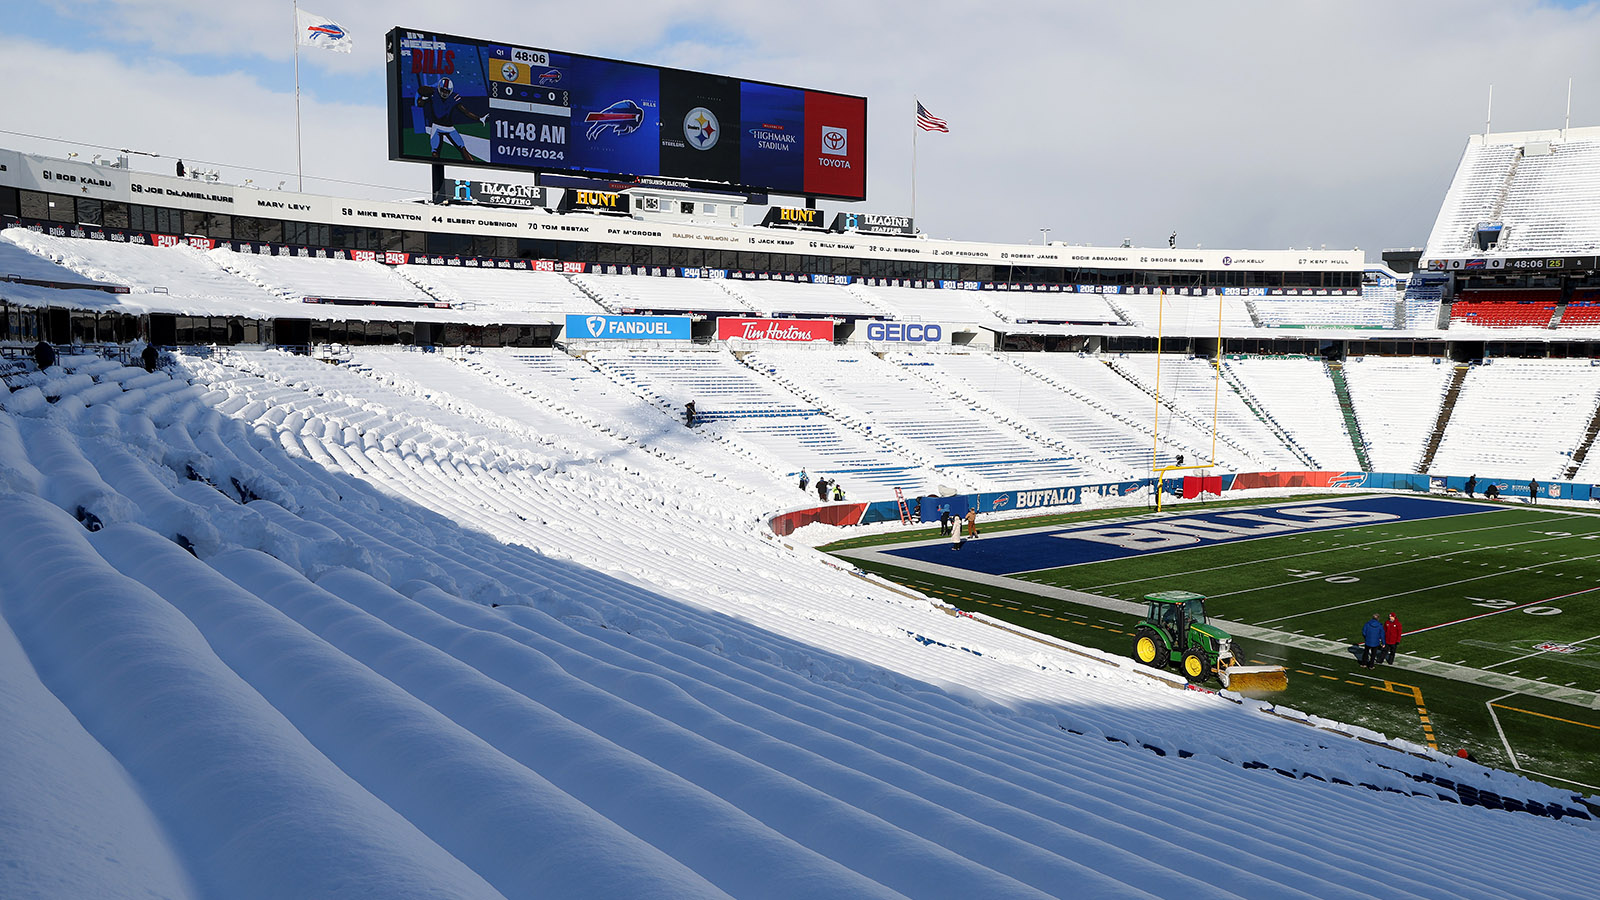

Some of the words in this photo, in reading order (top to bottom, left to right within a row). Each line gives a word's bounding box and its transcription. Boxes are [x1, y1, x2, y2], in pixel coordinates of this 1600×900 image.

[411, 49, 455, 75] BILLS
[514, 51, 546, 64] 48:06
[505, 87, 513, 95] 0
[548, 92, 556, 101] 0
[495, 120, 536, 142] 11:48
[540, 124, 566, 144] AM
[753, 130, 796, 143] HIGHMARK
[758, 140, 789, 151] STADIUM
[497, 146, 565, 161] 01/15/2024
[818, 157, 851, 169] TOYOTA
[43, 170, 52, 180] 61
[56, 173, 76, 182] BOB
[80, 177, 112, 187] KALSU
[131, 183, 142, 193] 68
[144, 187, 163, 195] JOE
[480, 182, 541, 199] IMAGINE
[576, 191, 619, 207] HUNT
[257, 200, 284, 208] MARV
[287, 203, 311, 211] LEVY
[341, 208, 353, 216] 58
[381, 212, 422, 221] STRATTON
[780, 208, 816, 223] HUNT
[478, 220, 518, 228] DUBENION
[864, 214, 909, 228] IMAGINE
[355, 251, 375, 262] 242
[385, 253, 405, 264] 243
[1223, 257, 1231, 265] 12
[535, 261, 554, 271] 243
[563, 262, 582, 272] 244
[1514, 260, 1543, 268] 48:06
[684, 268, 700, 278] 244
[709, 269, 725, 279] 200
[814, 275, 828, 284] 200
[834, 276, 848, 285] 201
[943, 280, 957, 289] 201
[964, 281, 978, 290] 202
[1380, 278, 1396, 286] 204
[1407, 278, 1423, 287] 205
[1079, 285, 1094, 293] 202
[1102, 286, 1118, 294] 203
[1249, 288, 1265, 296] 204
[609, 321, 672, 336] FANDUEL
[741, 321, 766, 340] Tim
[867, 323, 942, 342] GEICO
[1016, 488, 1076, 508] BUFFALO
[1048, 505, 1401, 551] BILLS
